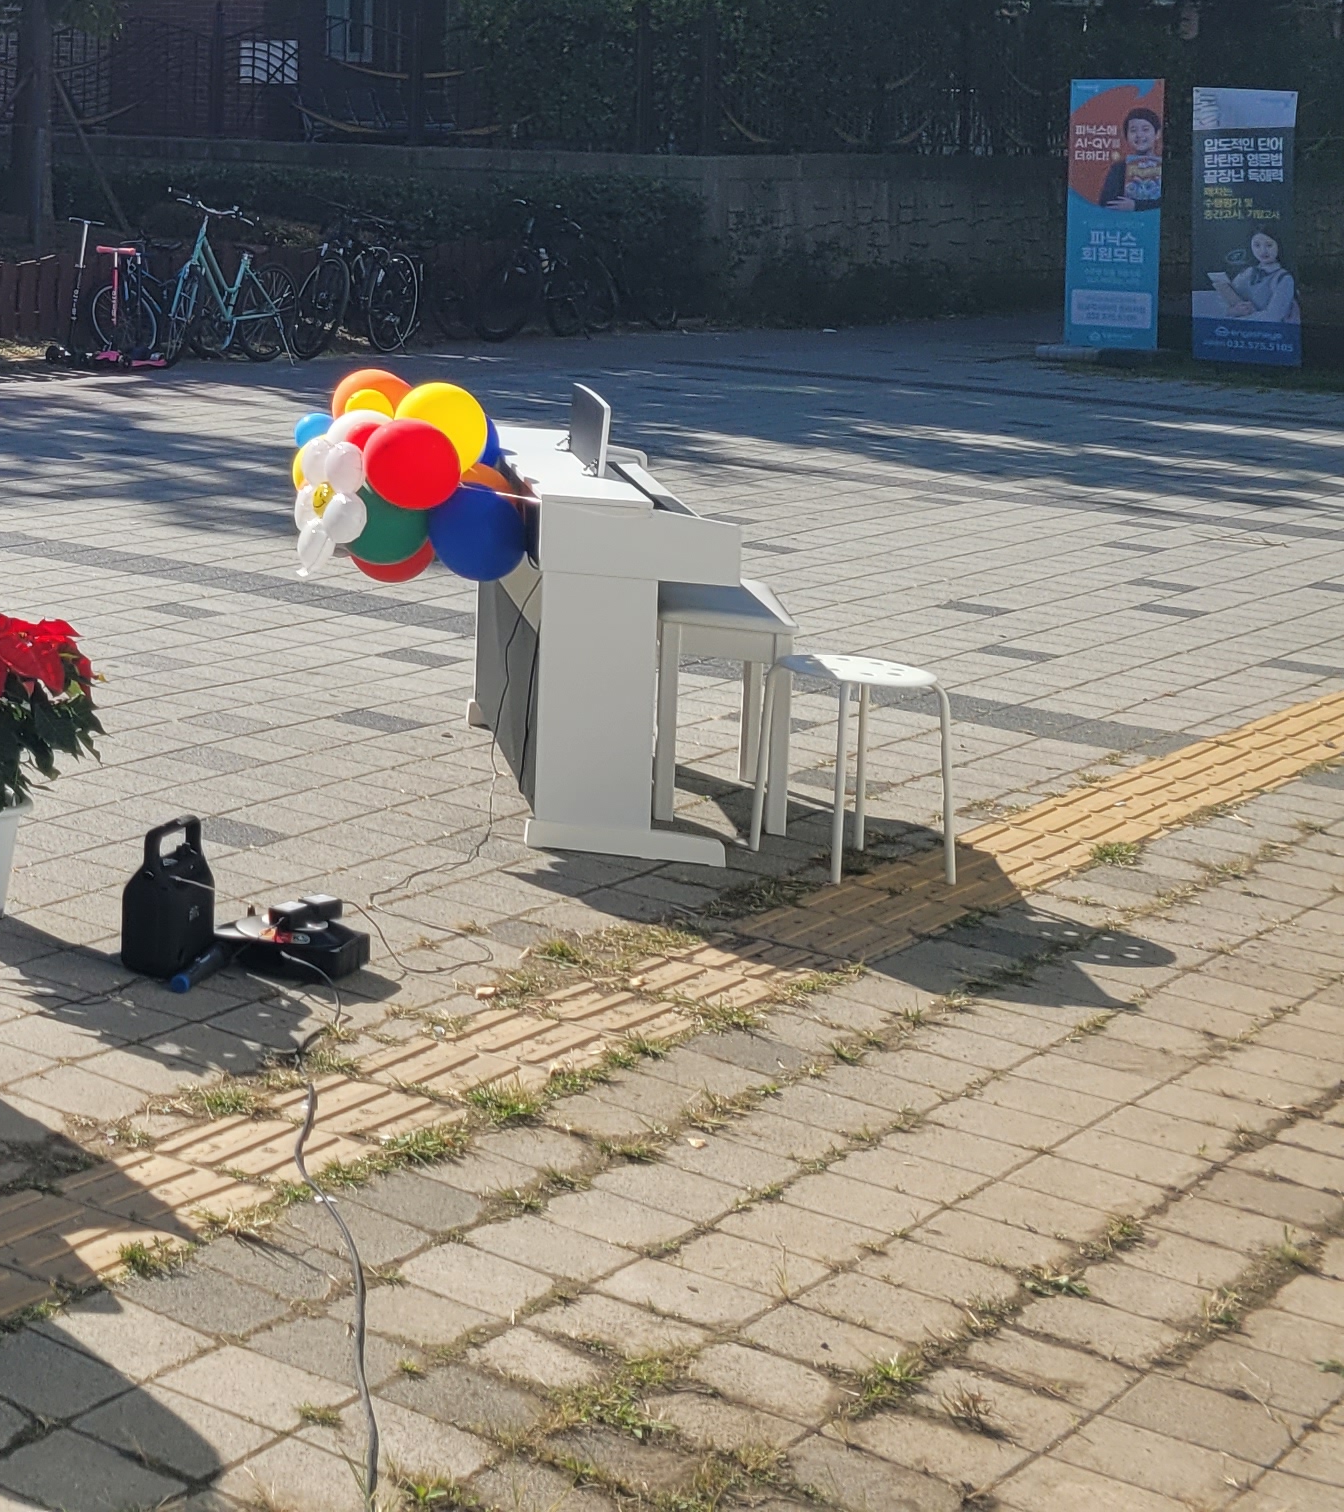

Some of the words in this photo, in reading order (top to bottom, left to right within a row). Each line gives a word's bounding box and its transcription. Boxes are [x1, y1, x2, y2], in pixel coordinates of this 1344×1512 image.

[1204, 138, 1254, 152] 압도적인
[1257, 137, 1283, 152] 단어
[1074, 150, 1110, 161] 더하다!
[1204, 153, 1243, 168] 탄탄한
[1247, 153, 1283, 167] 영문법
[1247, 169, 1284, 183] 독해력
[1090, 230, 1137, 246] 파닉스
[1082, 247, 1144, 263] 회원모집
